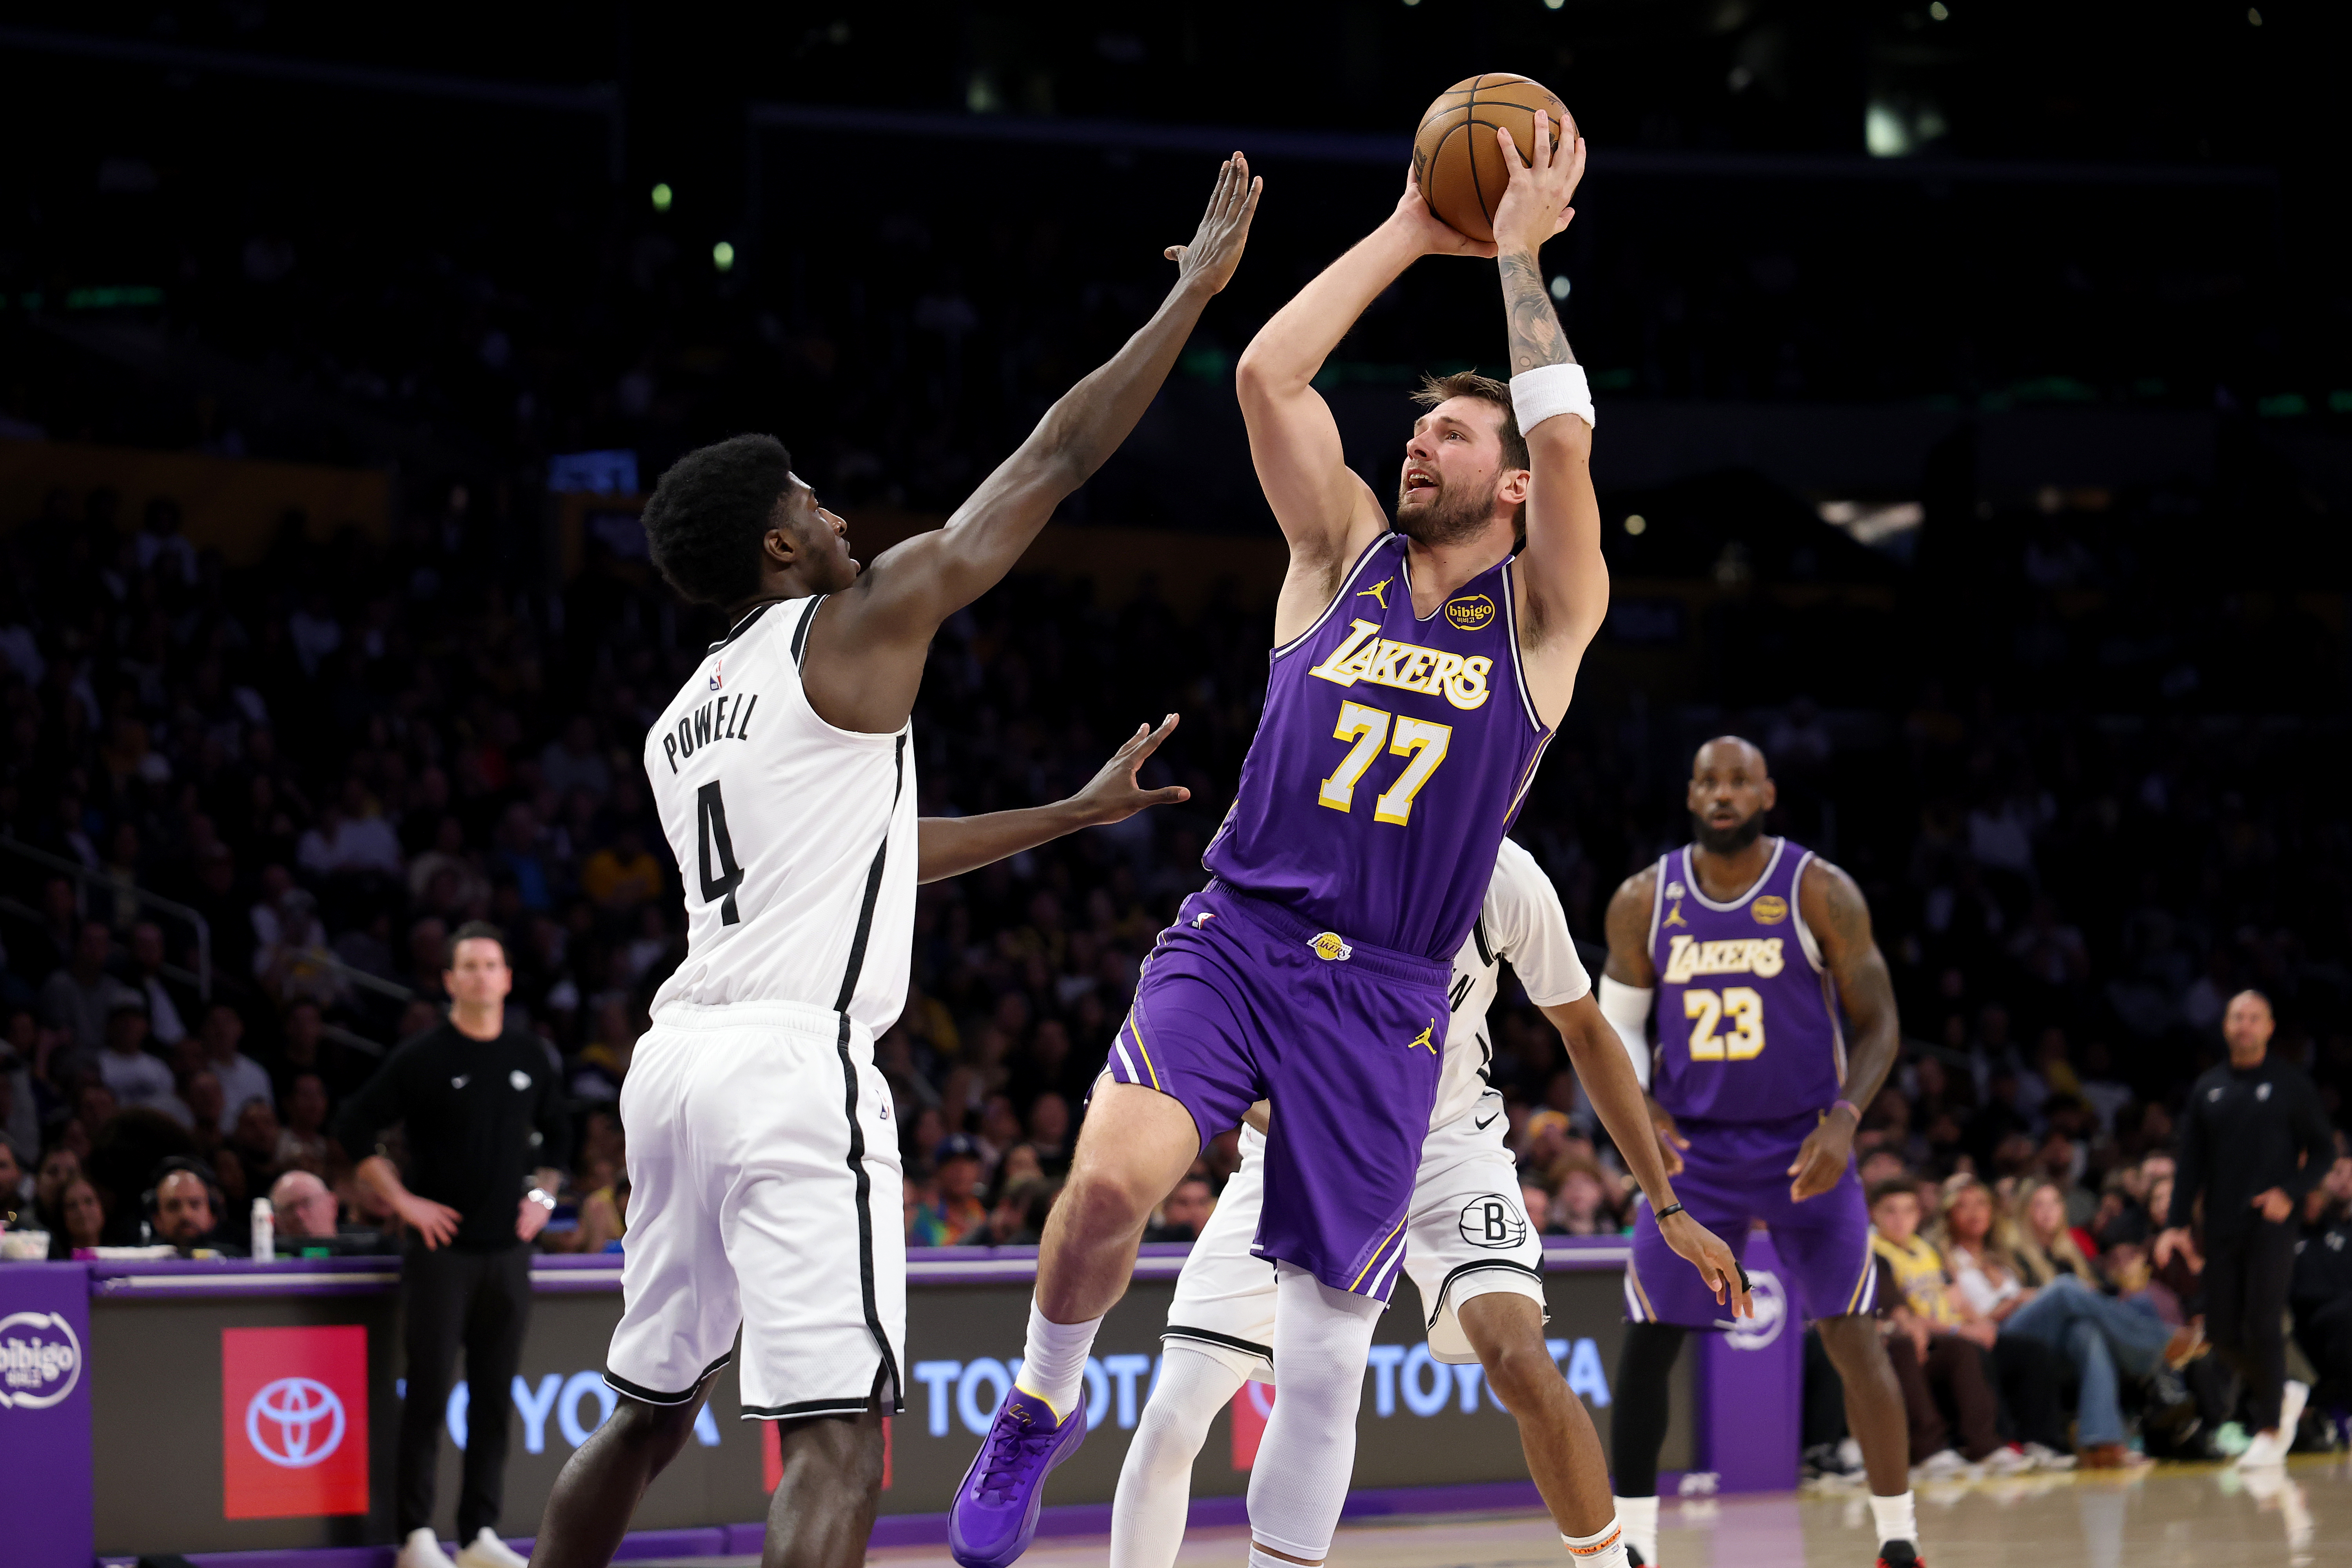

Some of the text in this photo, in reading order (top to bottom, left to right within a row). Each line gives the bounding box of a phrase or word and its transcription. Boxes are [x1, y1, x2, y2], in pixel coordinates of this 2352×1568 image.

[1450, 605, 1492, 619] bibigo
[1308, 618, 1493, 710] LAKERS
[663, 693, 758, 775] POWELL
[1318, 700, 1452, 826] 77
[698, 779, 745, 926] 4
[1308, 935, 1350, 959] LAKERS
[1663, 935, 1785, 984] LAKERS
[1684, 987, 1765, 1062] 23
[1485, 1203, 1506, 1240] B
